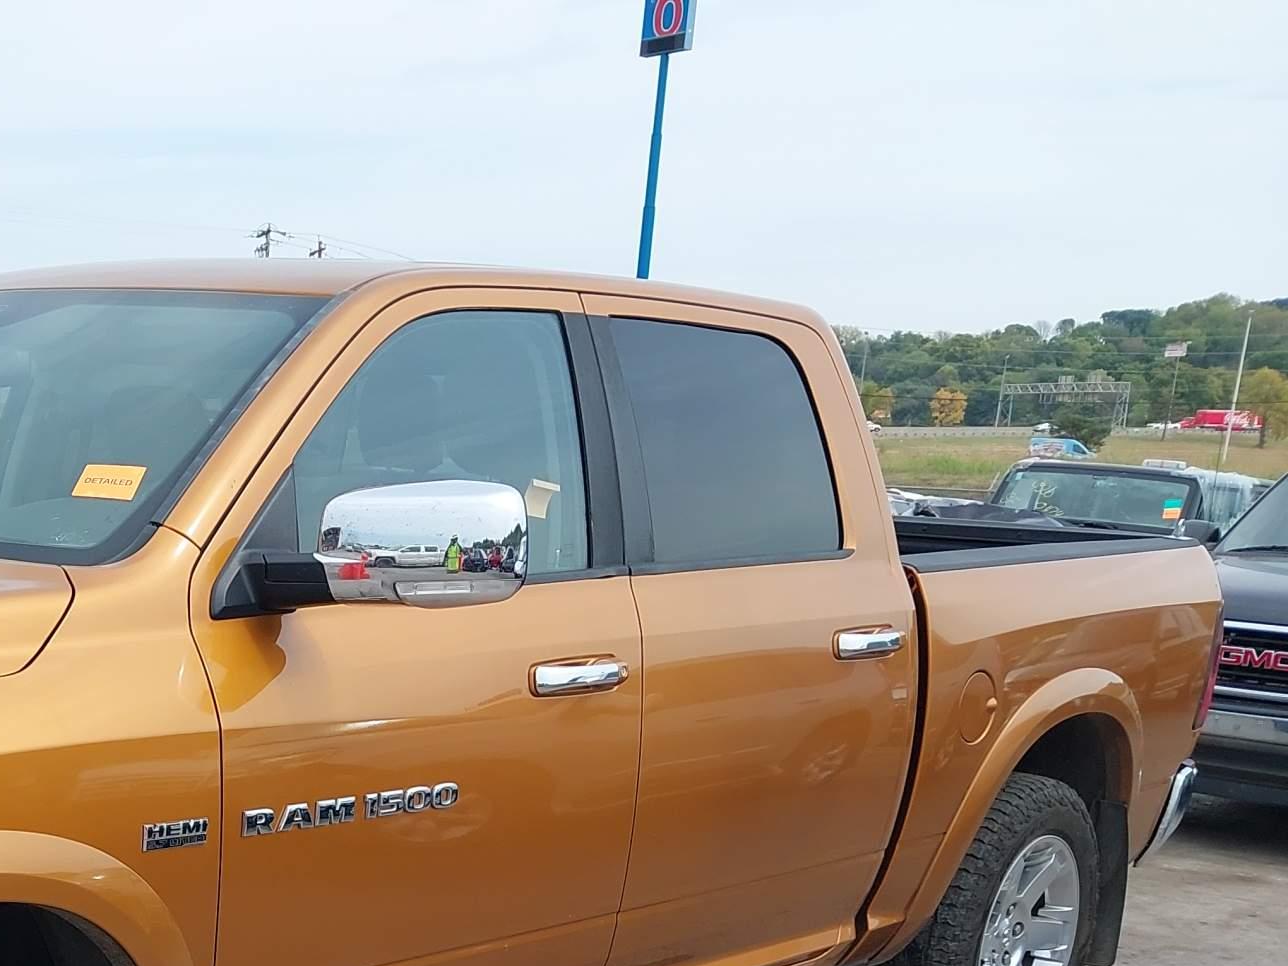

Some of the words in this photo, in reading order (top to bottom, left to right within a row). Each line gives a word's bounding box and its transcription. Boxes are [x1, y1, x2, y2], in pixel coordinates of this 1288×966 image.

[84, 476, 133, 486] DETAILED
[1218, 645, 1288, 672] GMC
[242, 796, 356, 837] RAM
[364, 782, 459, 818] 1500
[146, 819, 209, 840] HEMI
